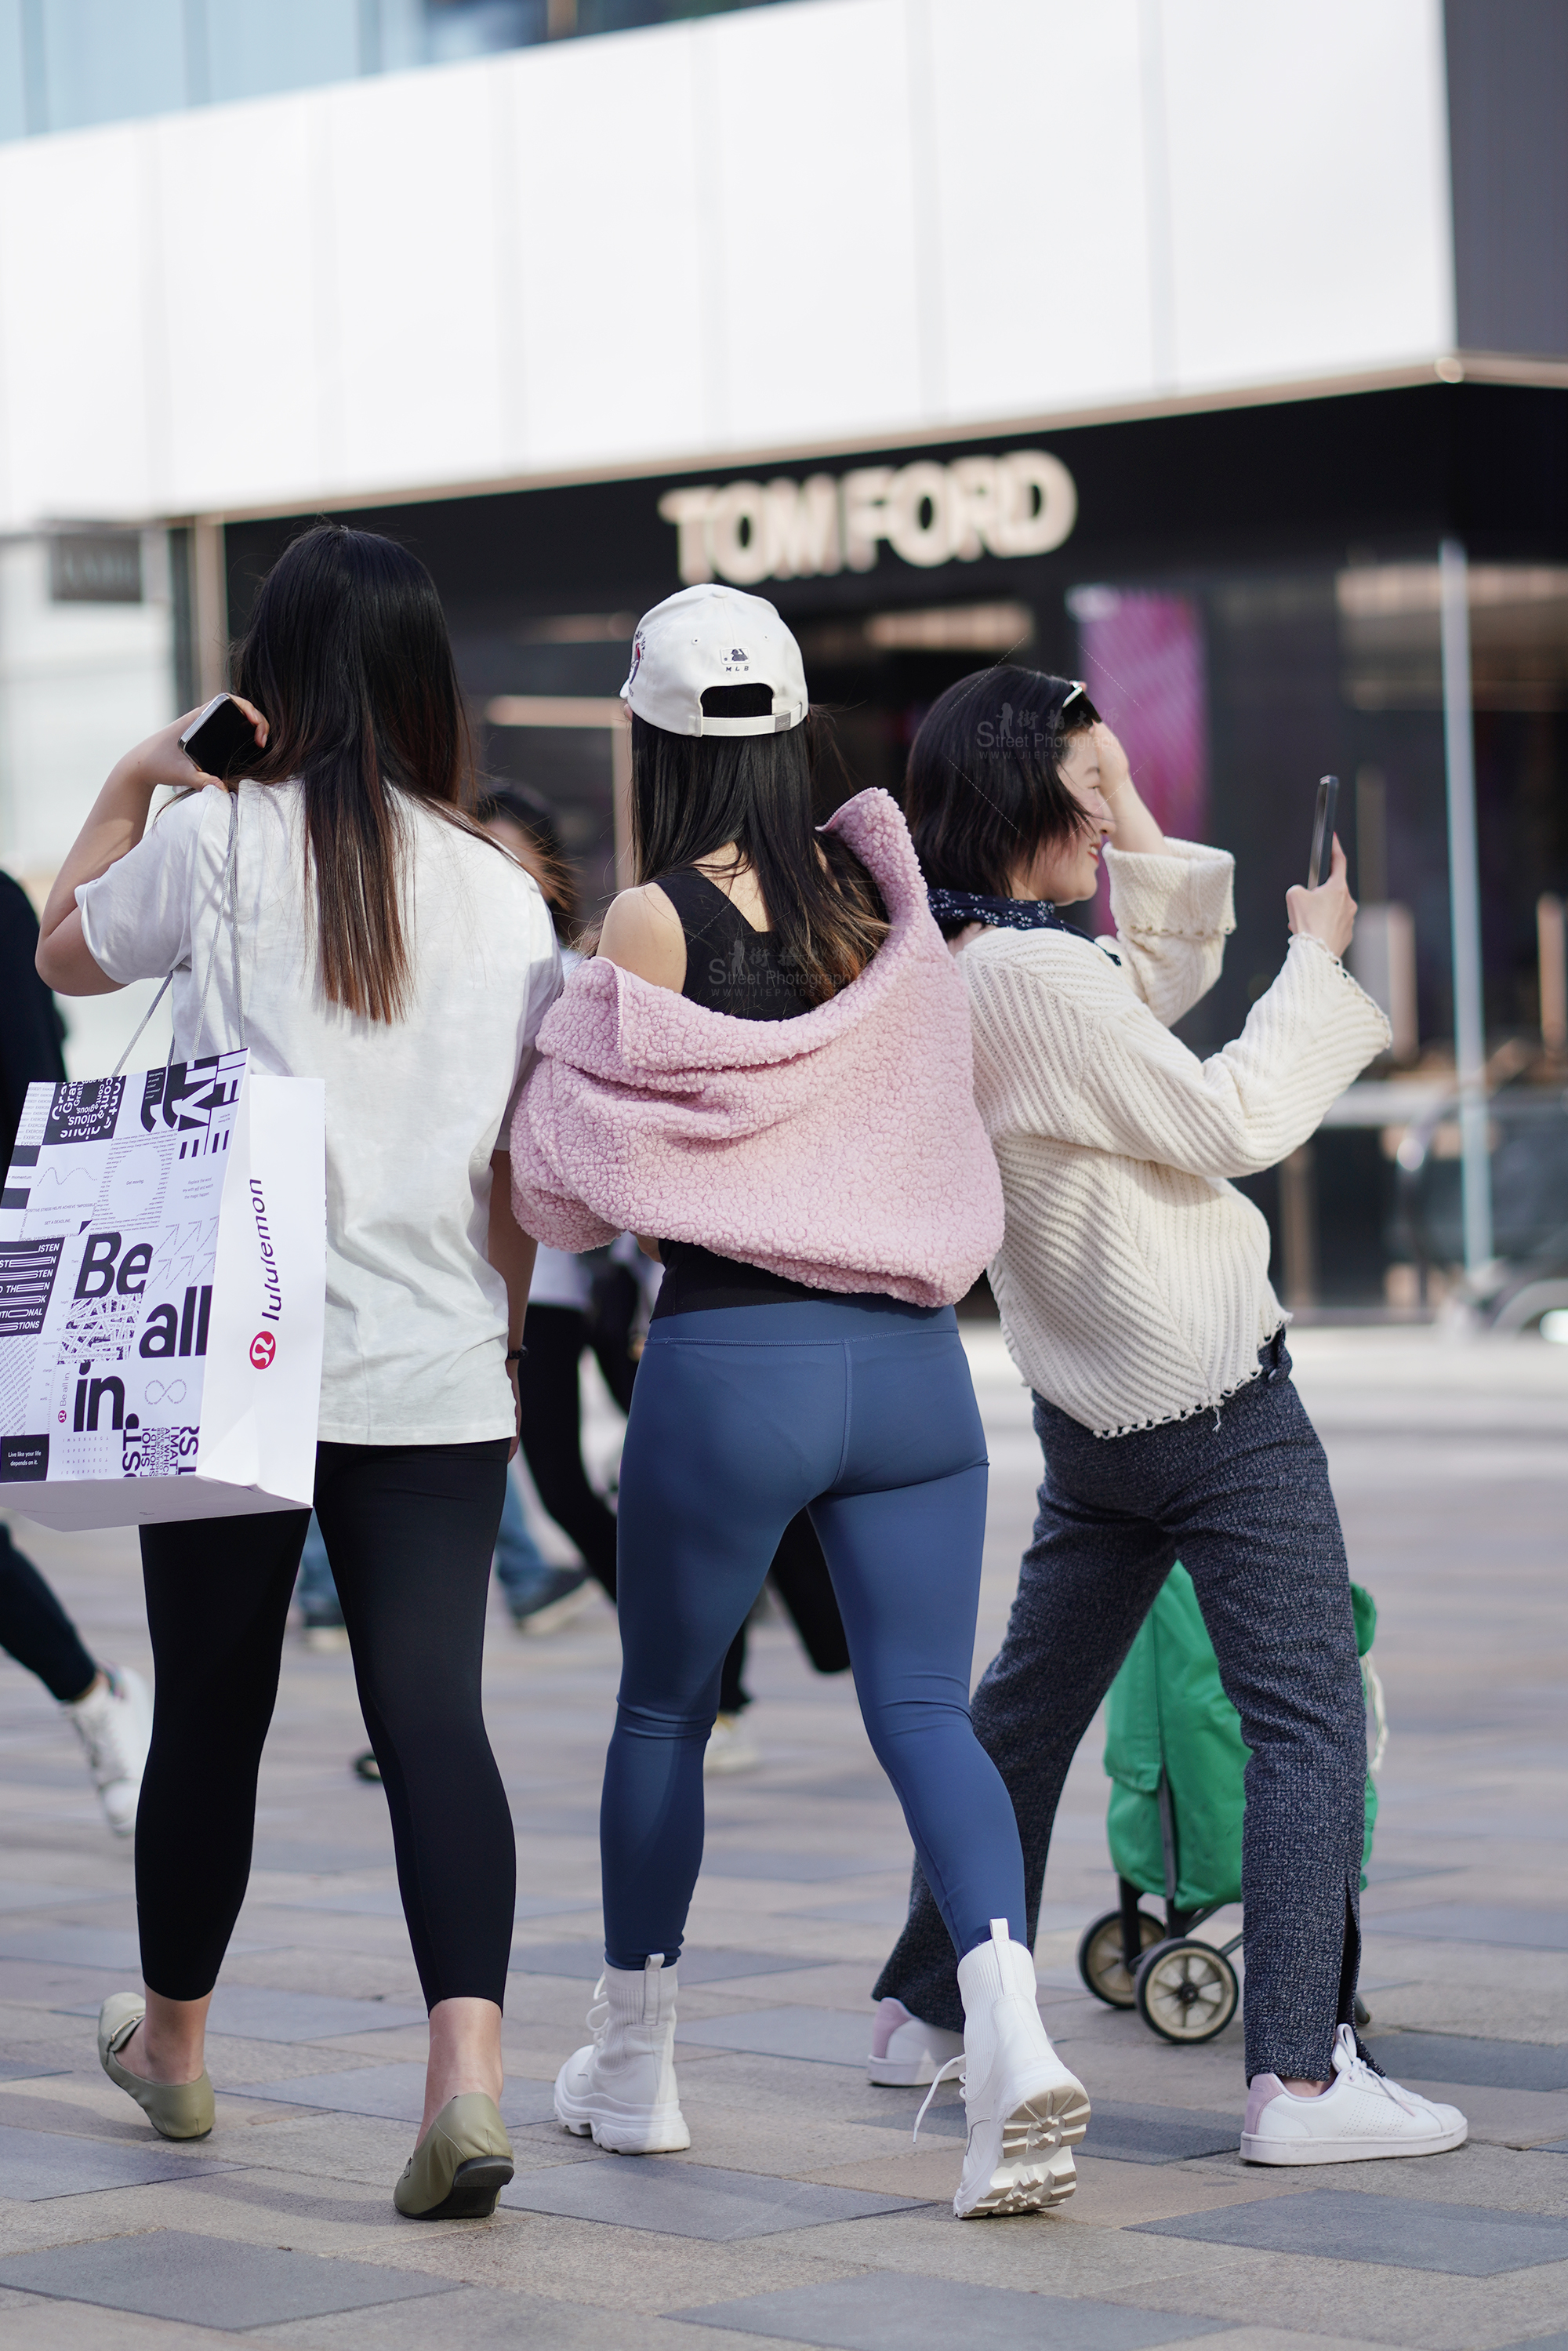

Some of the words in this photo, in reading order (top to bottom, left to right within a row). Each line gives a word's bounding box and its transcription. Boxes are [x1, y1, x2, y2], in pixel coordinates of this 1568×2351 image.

[658, 473, 842, 585] TOM
[843, 449, 1078, 572] FORD
[73, 1231, 153, 1299] Be
[249, 1179, 282, 1321] lululemon
[139, 1285, 213, 1358] all
[60, 1395, 67, 1407] Be
[73, 1362, 140, 1432] in.
